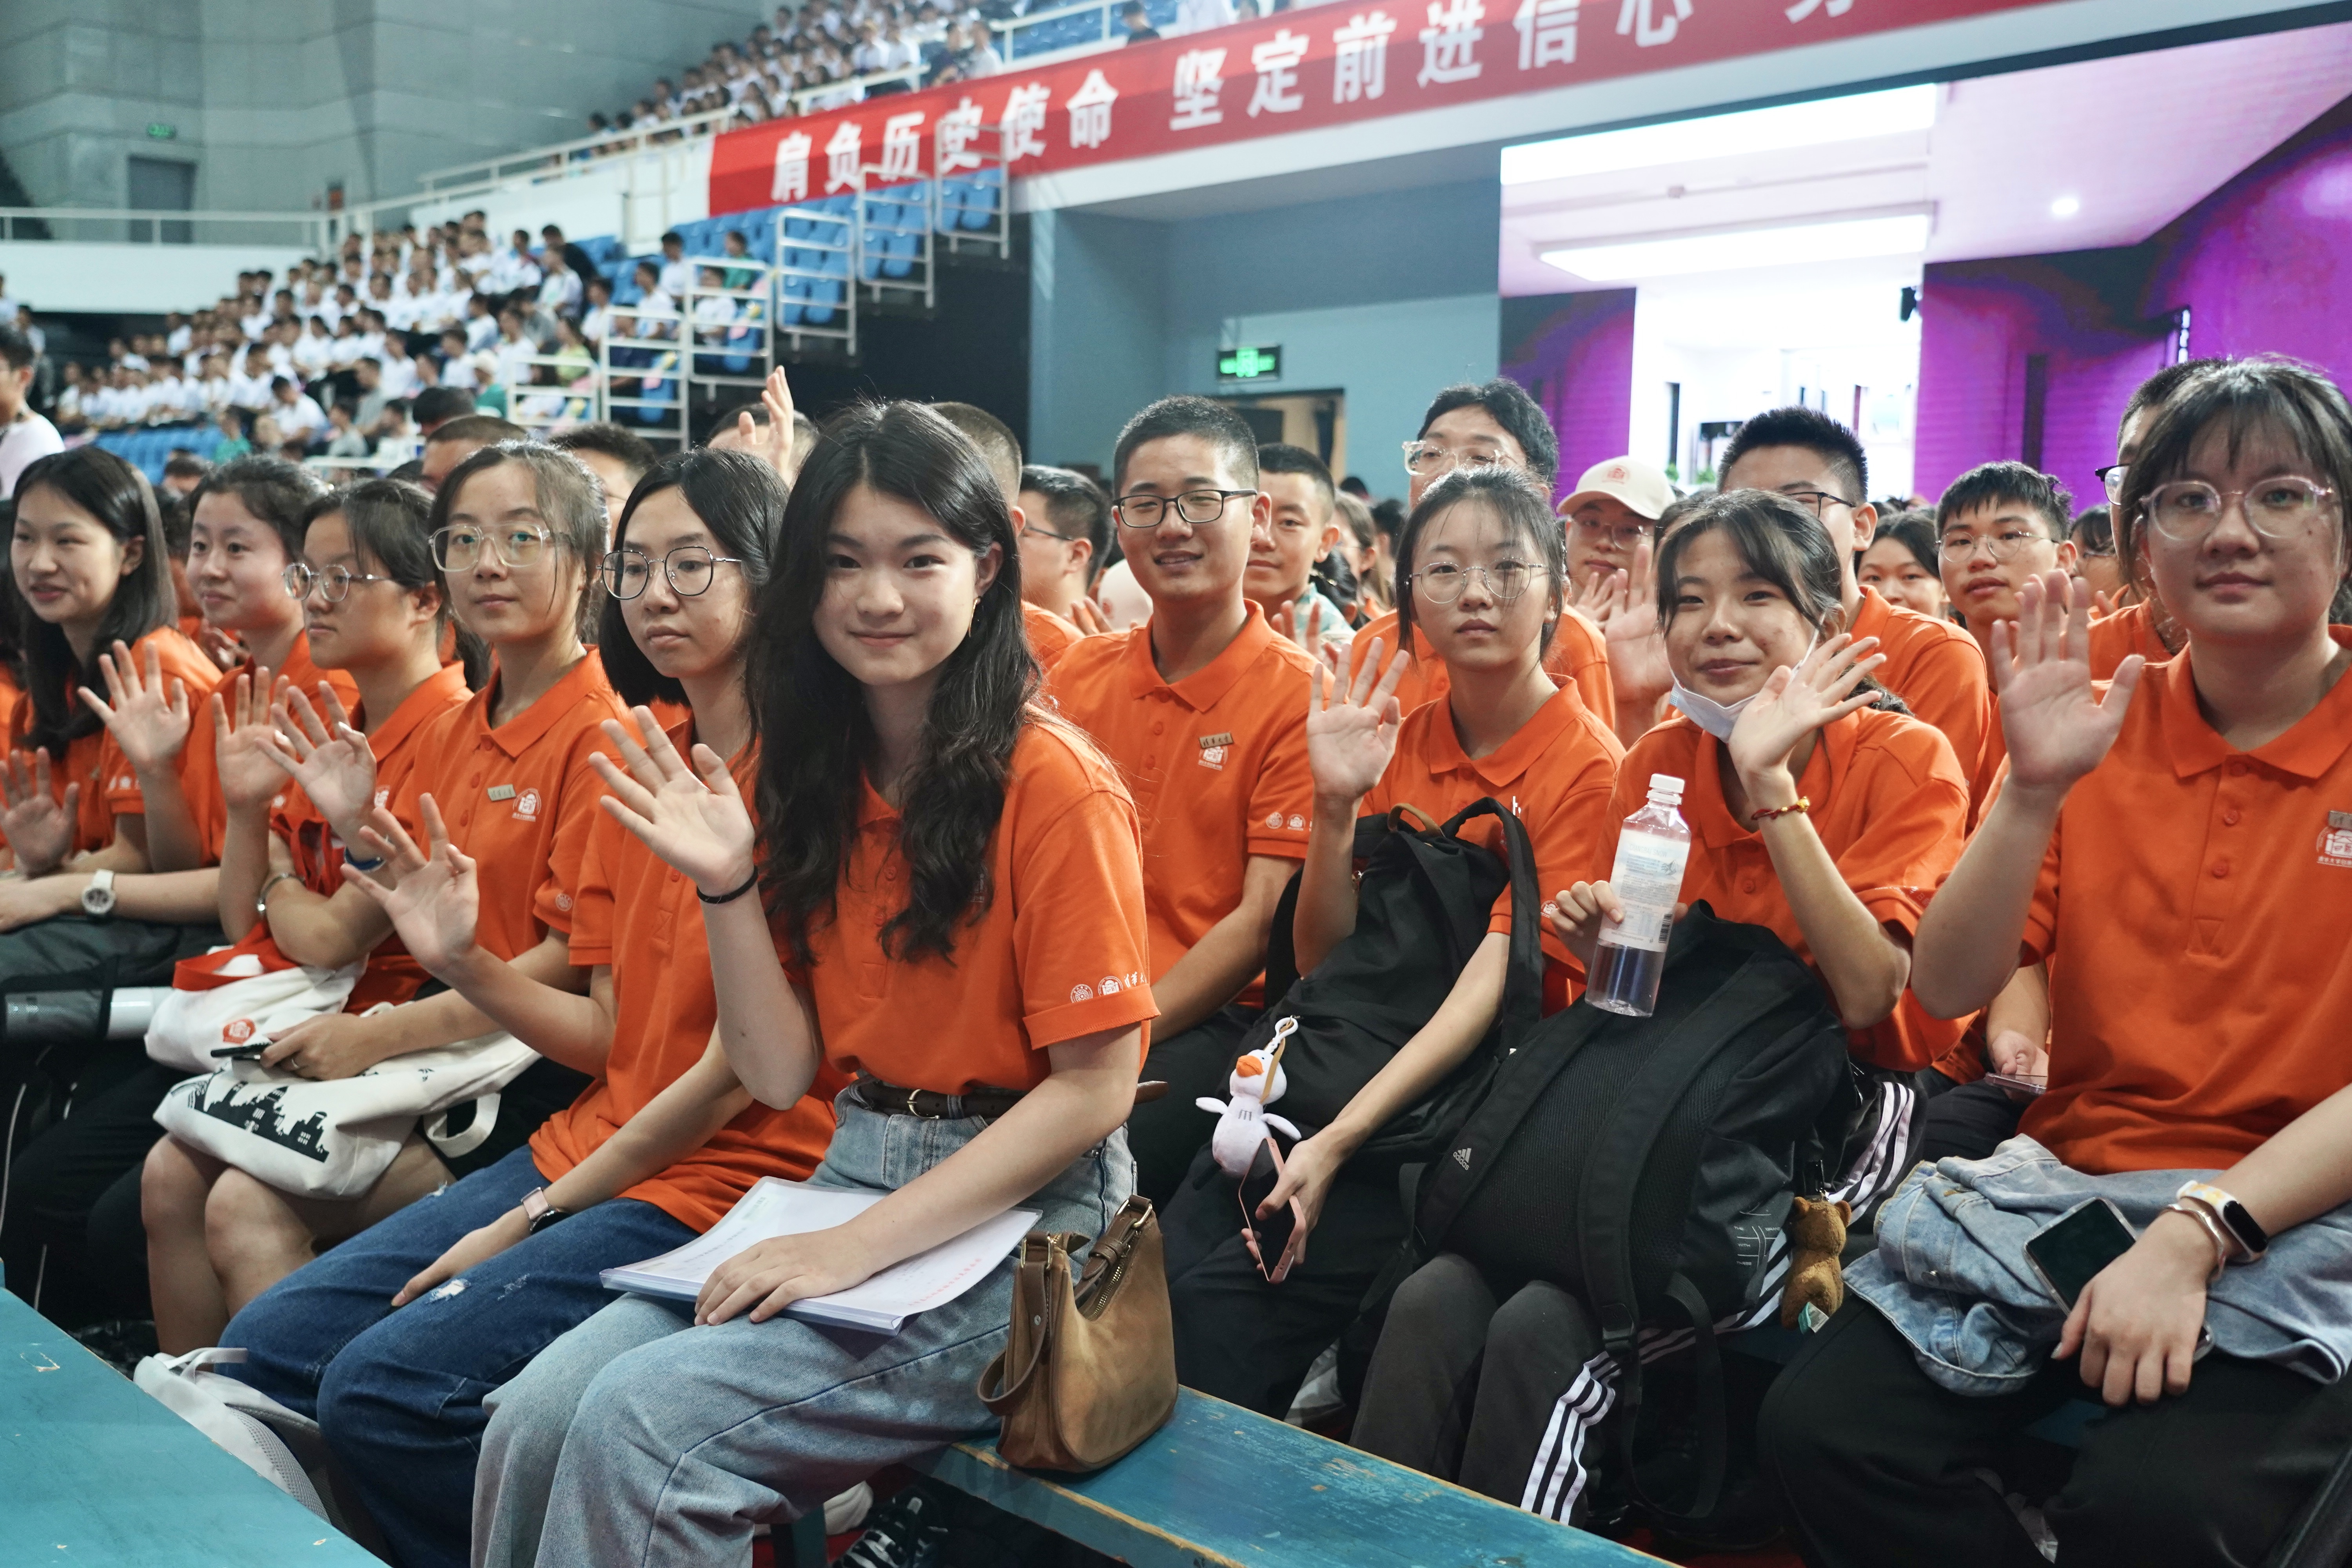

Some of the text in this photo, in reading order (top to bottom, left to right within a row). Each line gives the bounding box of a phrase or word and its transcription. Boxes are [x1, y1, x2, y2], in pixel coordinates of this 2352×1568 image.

[771, 0, 1694, 202] 肩负历史使命 坚定前进信心
[1653, 849, 1668, 858] SNOW
[1453, 1151, 1470, 1171] adidas
